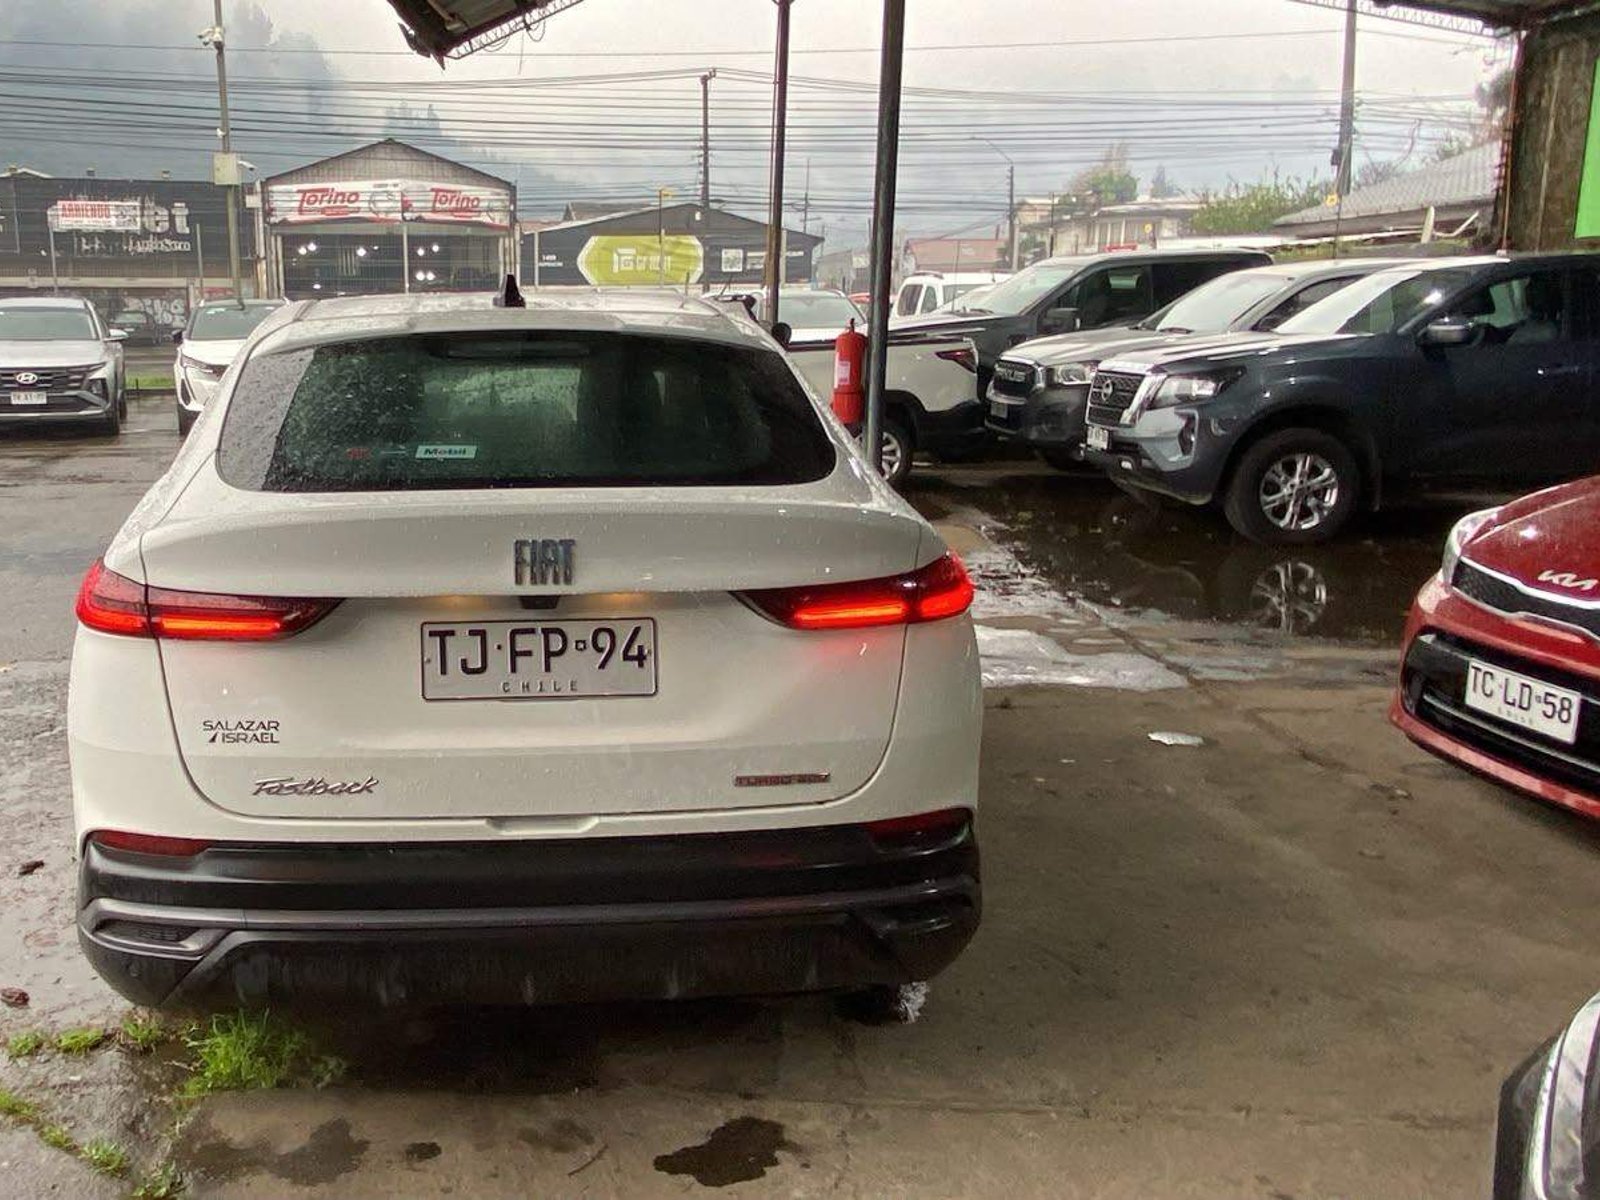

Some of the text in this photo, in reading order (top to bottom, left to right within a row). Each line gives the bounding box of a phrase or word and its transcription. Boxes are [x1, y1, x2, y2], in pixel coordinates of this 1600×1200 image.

[297, 188, 360, 215] Torino
[431, 188, 481, 213] Torino
[514, 539, 577, 585] FIAT
[501, 679, 579, 694] CHILE
[203, 720, 280, 732] SALAZAR
[221, 732, 280, 744] ISRAEL
[251, 775, 380, 797] Fastback
